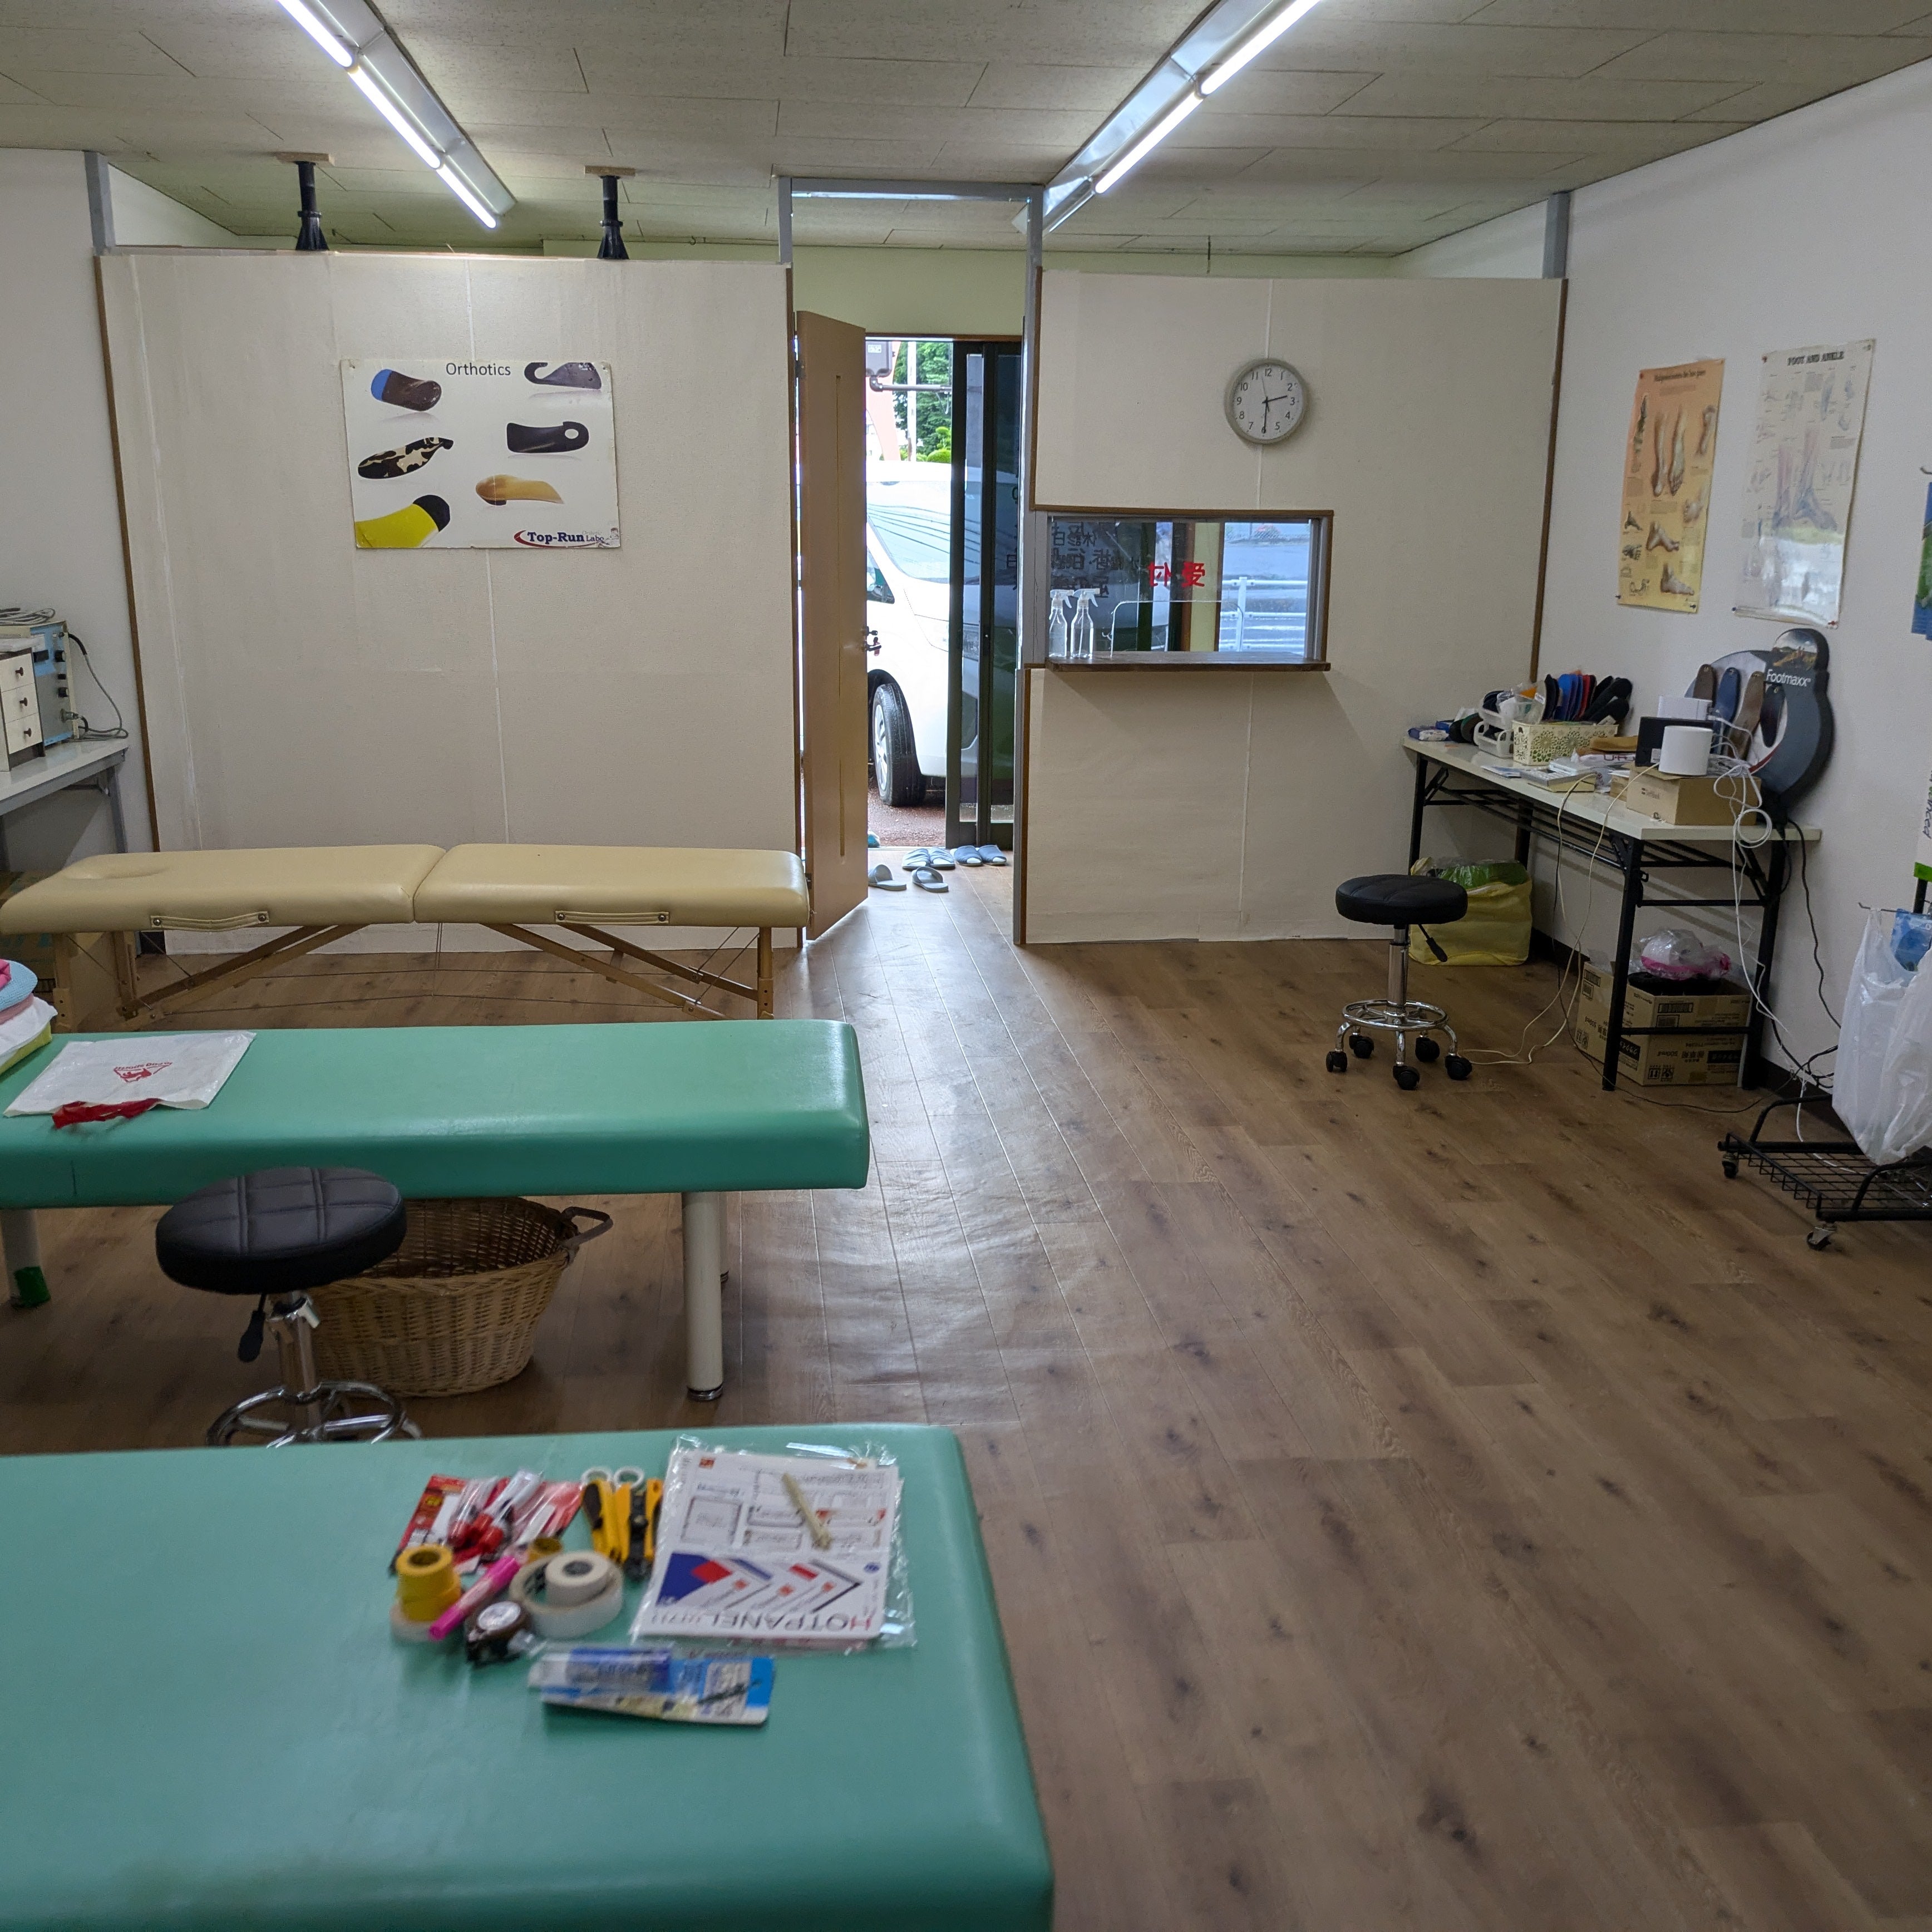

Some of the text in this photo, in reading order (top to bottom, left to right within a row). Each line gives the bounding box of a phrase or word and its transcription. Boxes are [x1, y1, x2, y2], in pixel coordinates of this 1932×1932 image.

[446, 362, 511, 377] Orthotics
[1265, 368, 1272, 377] 12
[1251, 371, 1259, 380] 11
[1240, 382, 1248, 391] 10
[1287, 383, 1293, 392] 2
[1236, 397, 1242, 405] 9
[1290, 397, 1295, 406] 3
[1239, 411, 1245, 420] 8
[1285, 411, 1290, 420] 4
[1249, 421, 1254, 430] 7
[527, 531, 584, 544] Top-Run
[1766, 669, 1808, 687] Footmaxx
